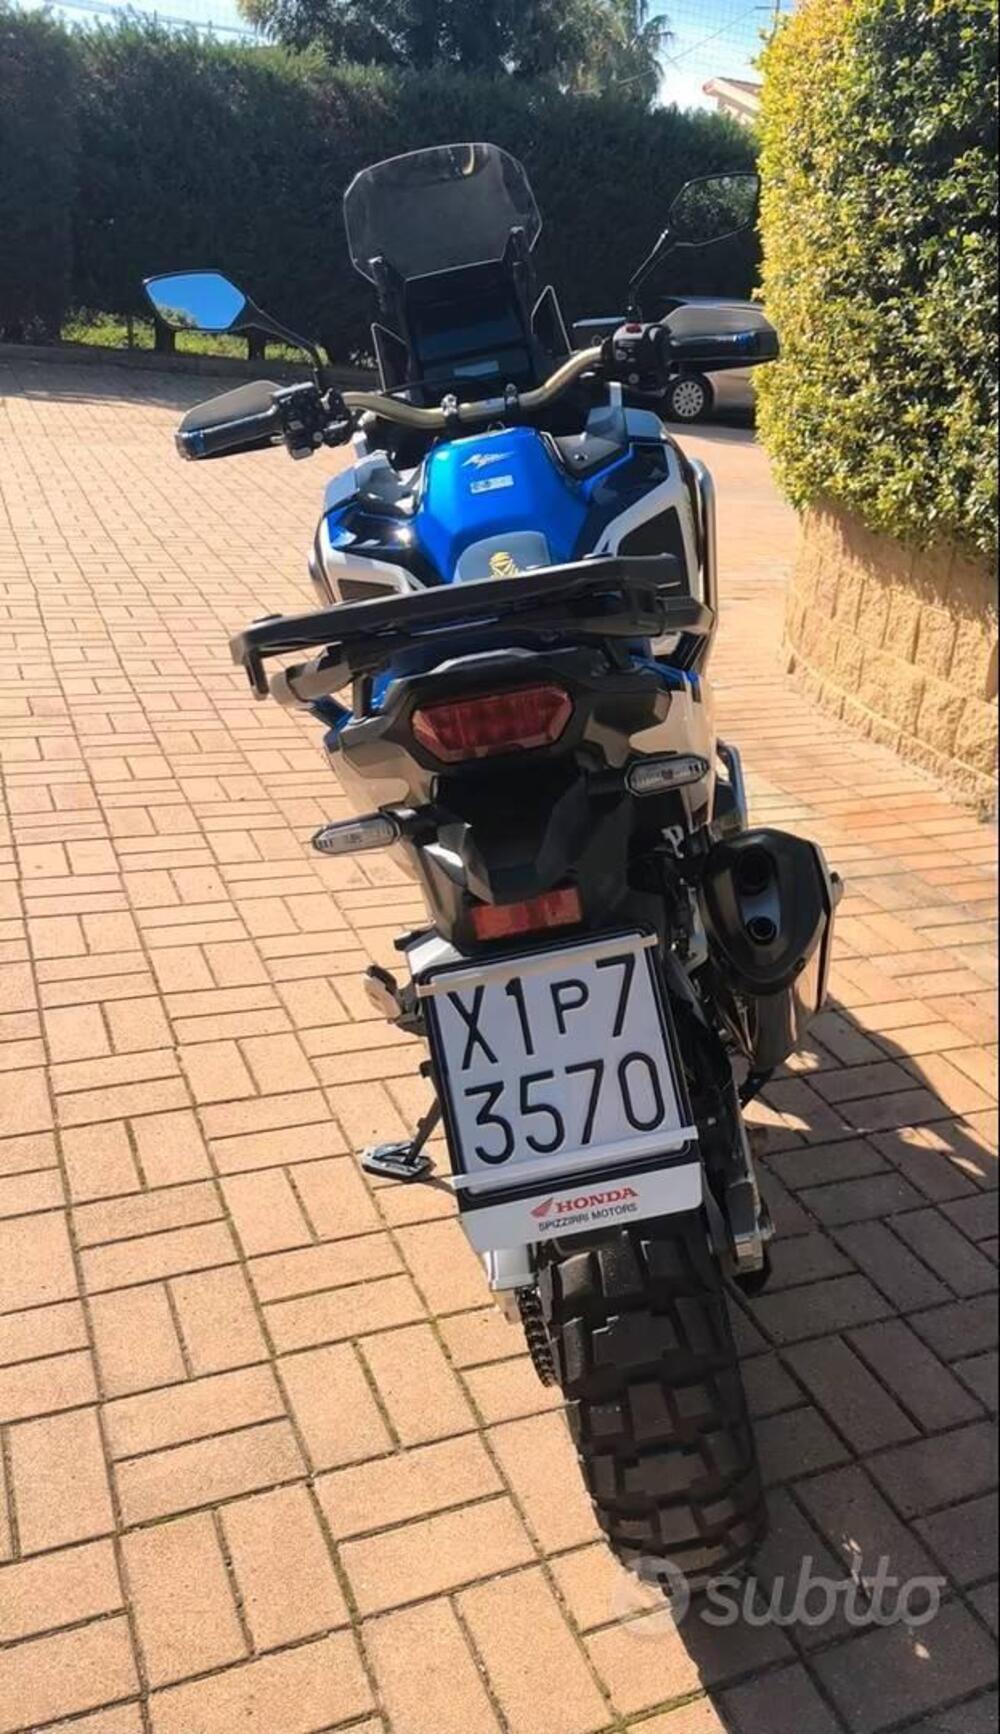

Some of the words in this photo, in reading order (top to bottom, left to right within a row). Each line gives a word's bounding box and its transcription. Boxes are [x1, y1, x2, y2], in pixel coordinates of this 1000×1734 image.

[464, 1051, 665, 1164] 3570
[556, 1187, 638, 1213] HONDA
[591, 1202, 638, 1221] MOTORS
